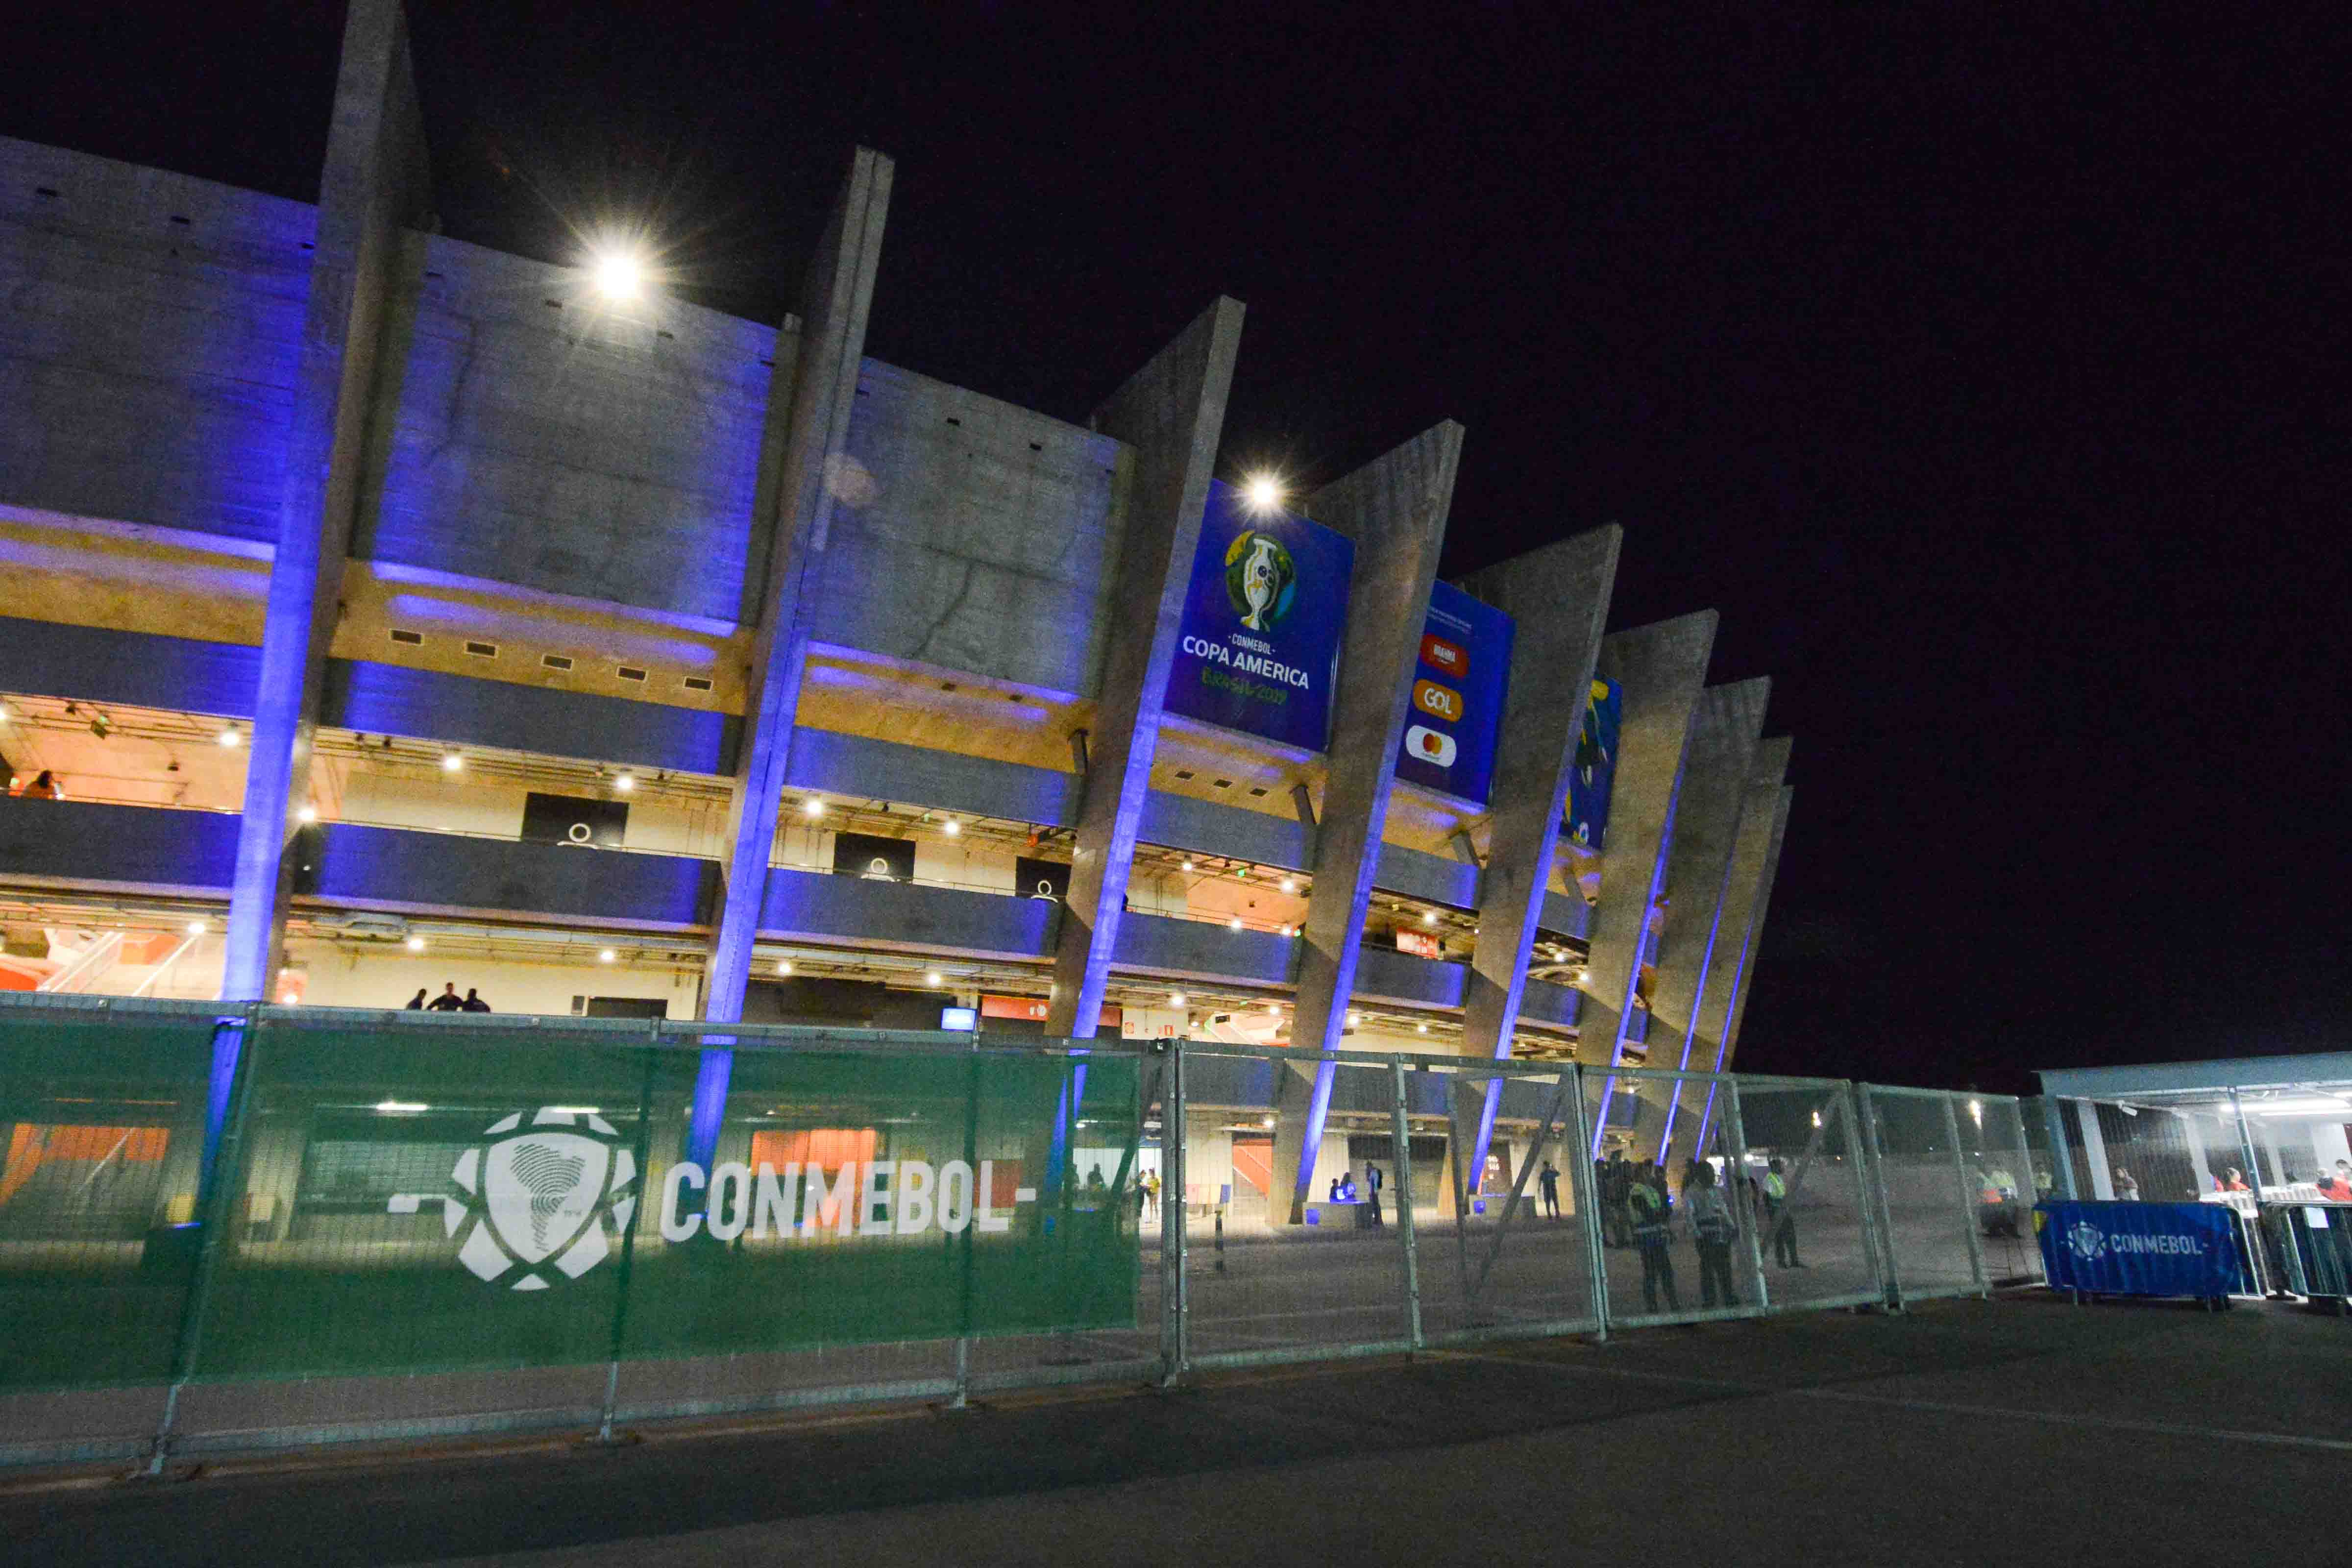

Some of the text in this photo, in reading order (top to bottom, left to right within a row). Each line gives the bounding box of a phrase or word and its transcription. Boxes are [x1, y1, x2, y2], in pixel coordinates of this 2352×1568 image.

[1183, 636, 1309, 690] COPA AMERICA
[1424, 687, 1453, 714] GOL
